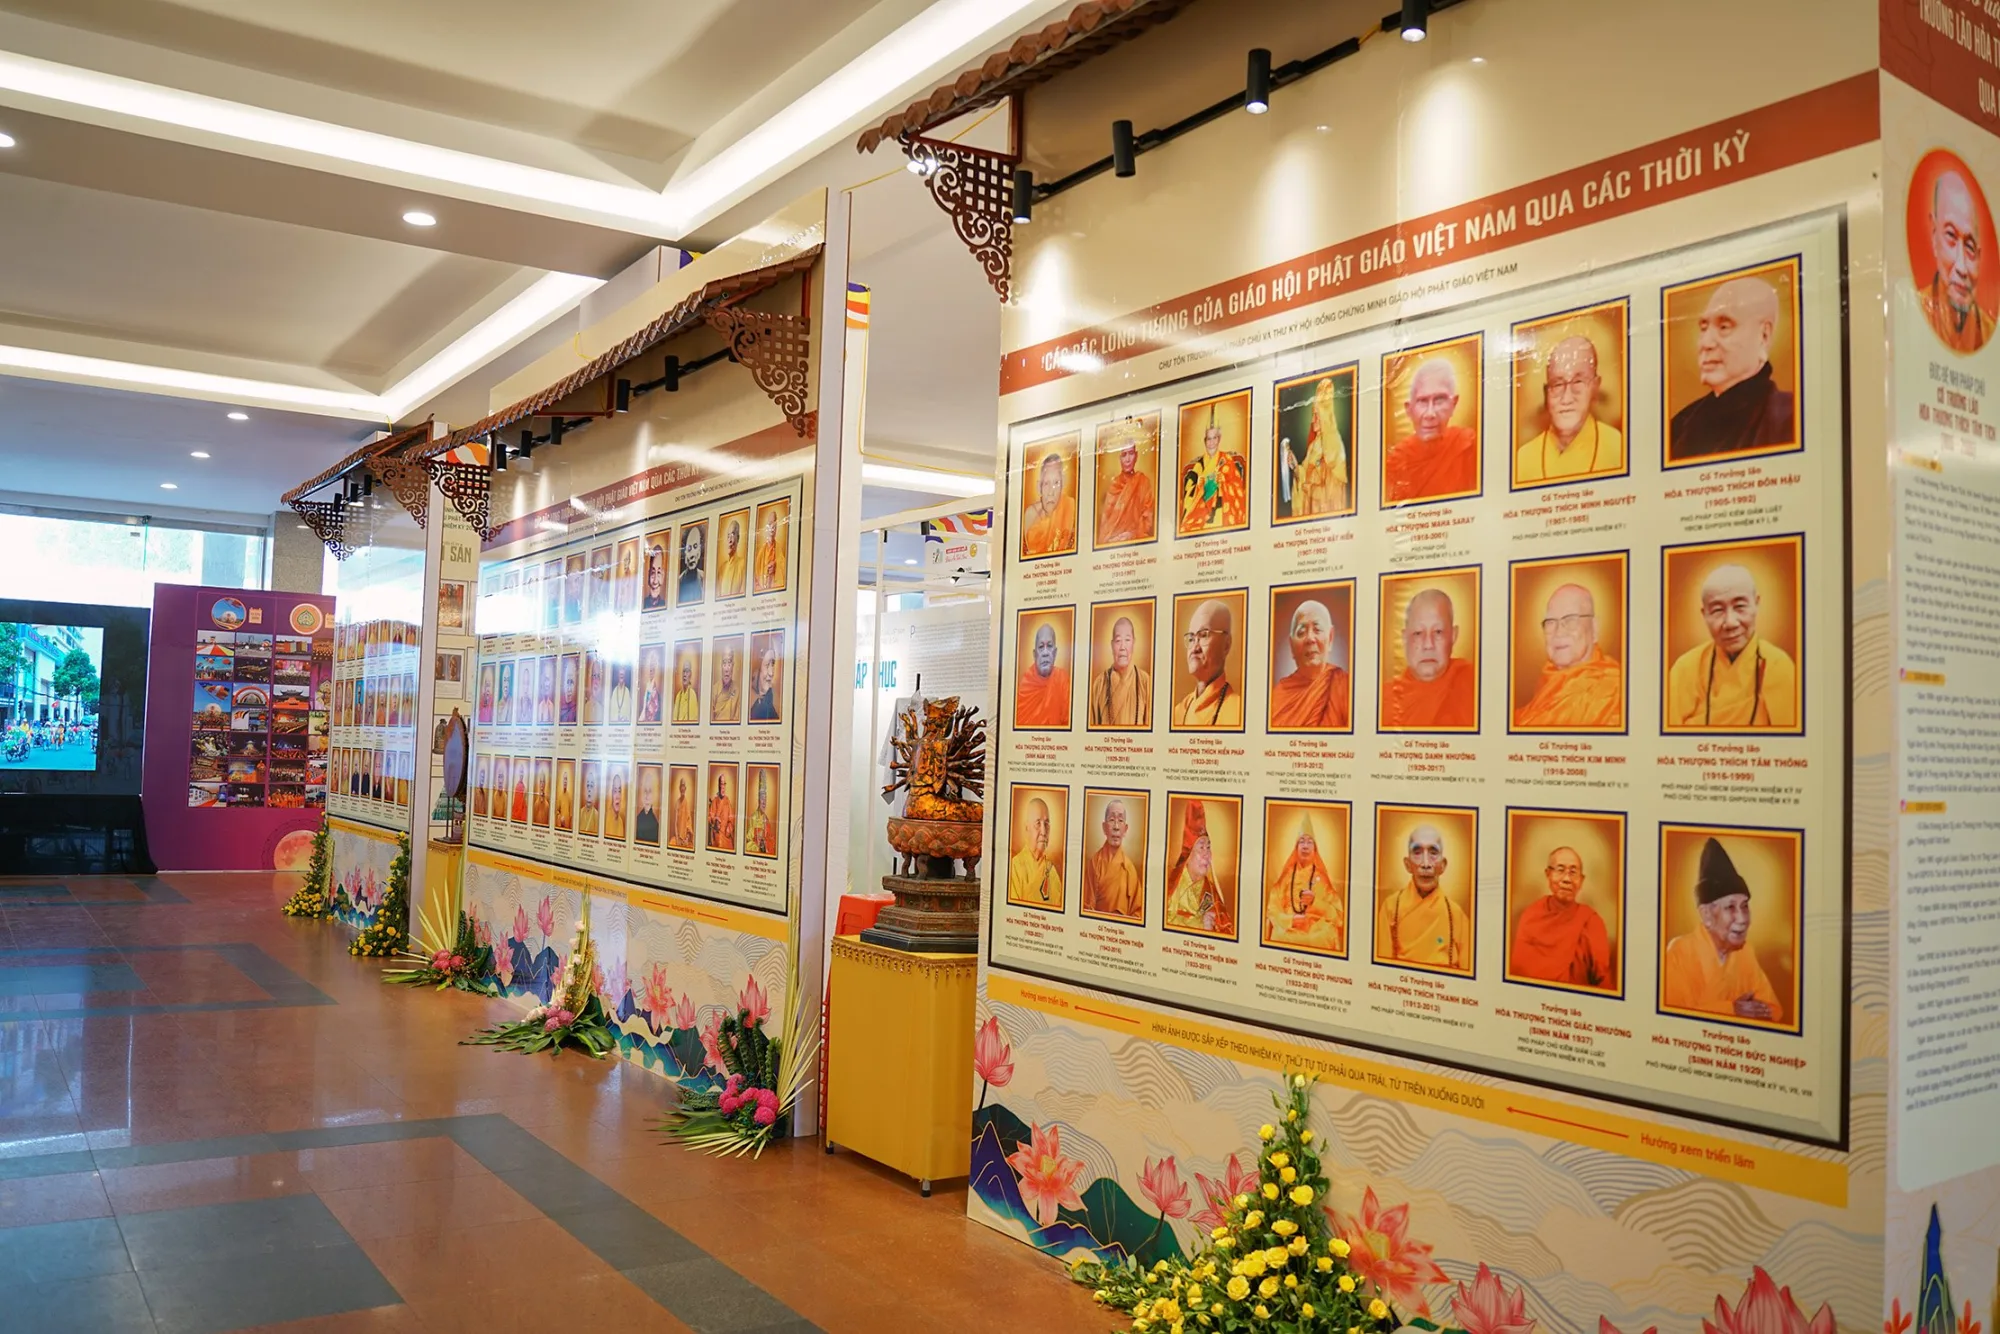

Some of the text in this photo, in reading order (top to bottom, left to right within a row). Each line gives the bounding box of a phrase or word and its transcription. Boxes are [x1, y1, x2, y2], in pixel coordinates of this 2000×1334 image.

[1974, 23, 1992, 65] HÒA
[1101, 327, 1136, 355] LONG
[1193, 297, 1223, 326] CỦA
[1229, 283, 1266, 315] GIÁO
[1272, 269, 1301, 303] HỘI
[1307, 253, 1354, 292] PHẬT
[1360, 239, 1406, 275] GIÁO
[1413, 221, 1458, 259] VIỆT
[1465, 206, 1516, 244] NAM
[1525, 188, 1574, 227] QUA
[1583, 170, 1631, 210] CÁC
[1640, 147, 1701, 192] THỜI
[1713, 128, 1750, 171] KỲ
[1366, 297, 1388, 312] MINH
[1497, 262, 1518, 277] NAM
[1664, 489, 1683, 499] HÒA
[1686, 485, 1724, 497] THƯỢNG
[1726, 480, 1755, 492] THÍCH
[1781, 474, 1801, 485] HẬU
[1699, 473, 1712, 481] Cố
[1555, 501, 1578, 513] THÍCH
[450, 544, 471, 563] SẢN
[1697, 743, 1709, 752] Cố
[1508, 753, 1523, 762] HÒA
[1526, 754, 1559, 764] THƯỢNG
[1561, 753, 1585, 763] THÍCH
[1605, 756, 1626, 764] MINH
[1657, 757, 1675, 765] HÒA
[1678, 757, 1717, 768] THƯỢNG
[1720, 756, 1748, 767] THÍCH
[1775, 758, 1808, 768] THÔNG
[1495, 1007, 1511, 1018] HÒA
[1514, 1011, 1546, 1024] THƯỢNG
[1548, 1016, 1572, 1028] THÍCH
[1573, 1020, 1592, 1031] GIÁC
[1529, 1027, 1550, 1037] (SINH
[1702, 1029, 1751, 1045] Trưởng lão
[1651, 1034, 1807, 1070] HÒA THƯỢNG THÍCH ĐỨC NGHIỆP
[1152, 1021, 1166, 1033] HÌNH
[1168, 1024, 1181, 1038] ẢNH
[1182, 1030, 1201, 1043] ĐƯỢC
[1216, 1036, 1228, 1048] XẾP
[1230, 1041, 1248, 1054] THEO
[1250, 1046, 1271, 1061] NHIỆM
[1329, 1064, 1348, 1076] PHẢI
[1348, 1070, 1365, 1081] QUA
[1367, 1072, 1387, 1087] TRÁI,
[1403, 1081, 1426, 1096] TRÊN
[1427, 1085, 1460, 1103] XUỐNG
[1460, 1094, 1485, 1109] DƯỚI
[1688, 1054, 1713, 1067] (SINH
[1716, 1059, 1737, 1071] NĂM
[1641, 1133, 1755, 1169] Hướng xem triển lãm
